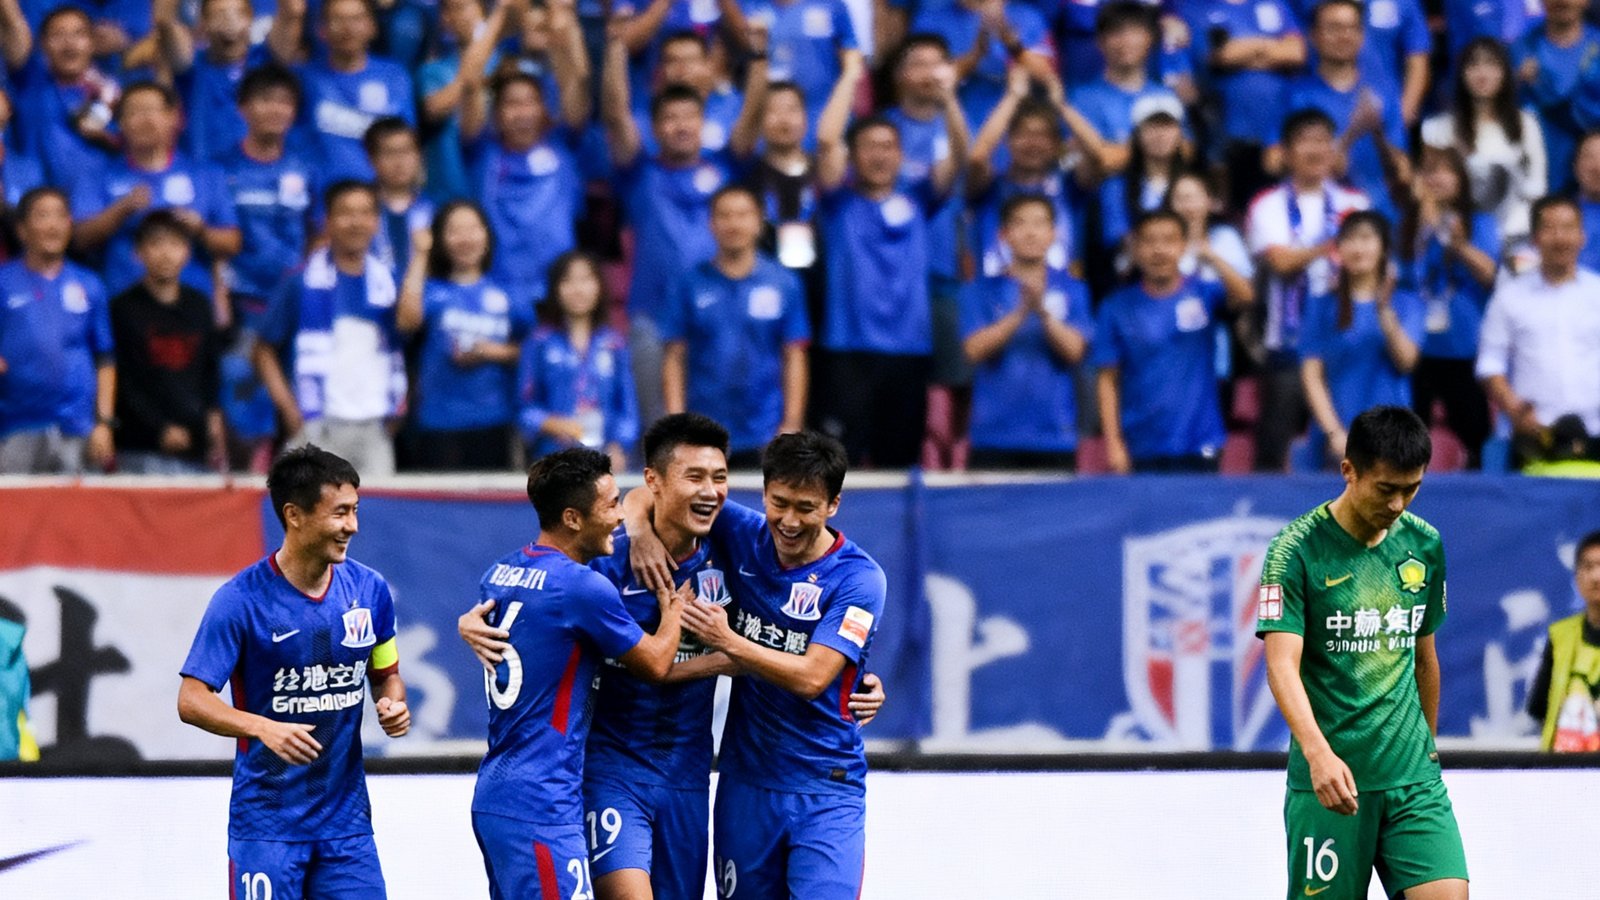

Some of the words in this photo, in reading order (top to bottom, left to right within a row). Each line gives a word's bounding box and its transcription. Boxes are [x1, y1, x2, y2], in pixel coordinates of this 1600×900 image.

[586, 807, 622, 850] 19
[1303, 836, 1339, 881] 16
[241, 872, 272, 900] 10
